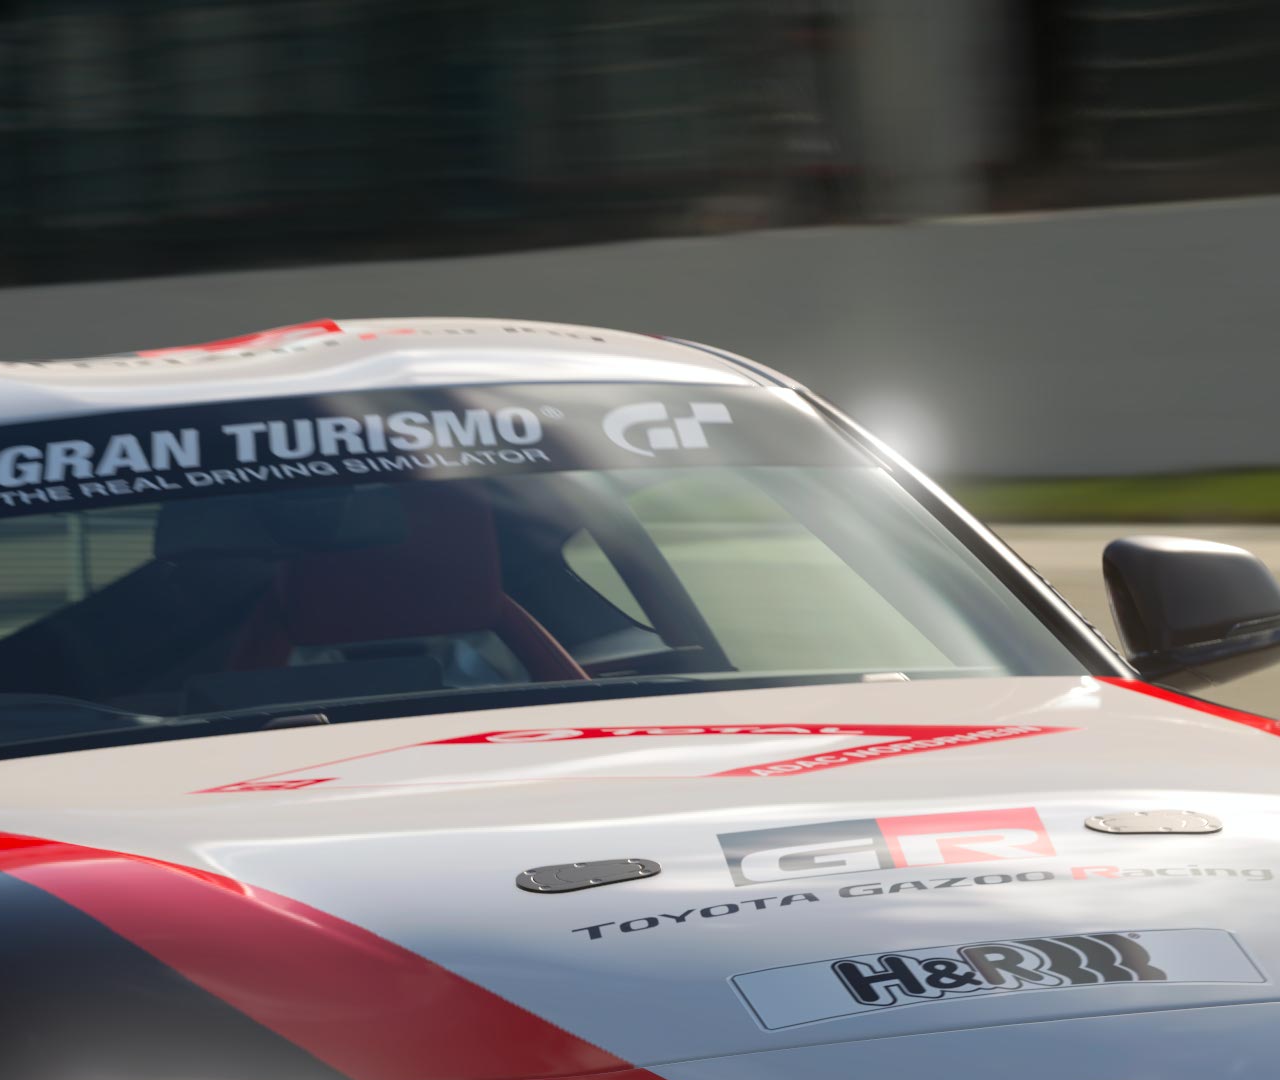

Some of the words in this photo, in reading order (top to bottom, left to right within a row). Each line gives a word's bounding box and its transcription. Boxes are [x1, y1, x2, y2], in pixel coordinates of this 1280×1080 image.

[221, 406, 543, 464] TURISMO
[80, 467, 183, 498] REAL
[185, 459, 339, 488] DRIVING
[344, 448, 551, 475] SIMULATOR
[750, 754, 848, 777] ADAC
[740, 828, 1041, 883] GR
[571, 892, 821, 941] TOYOTA
[838, 870, 1055, 899] GAZOO
[1071, 863, 1275, 882] Racing
